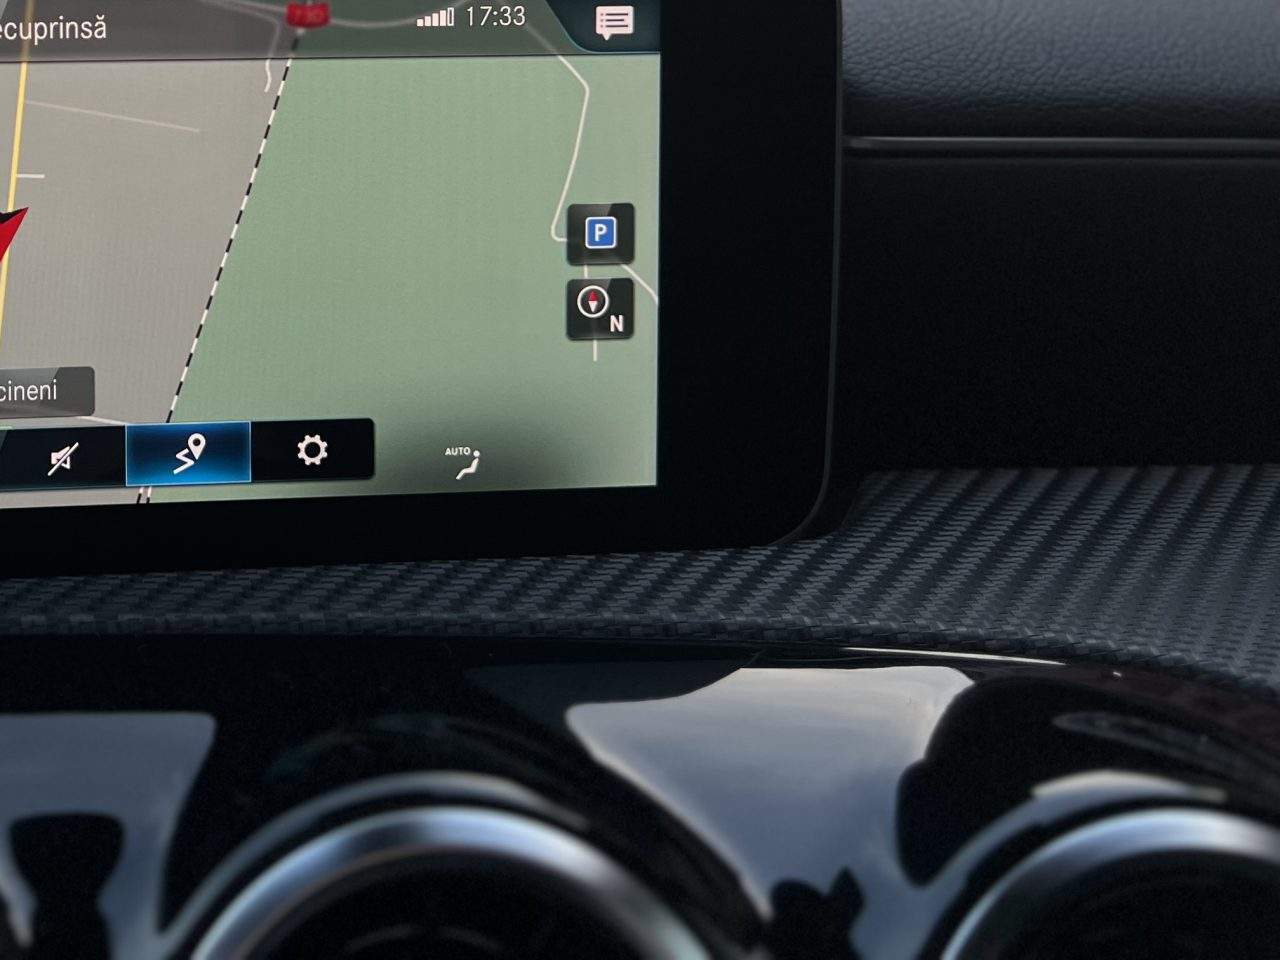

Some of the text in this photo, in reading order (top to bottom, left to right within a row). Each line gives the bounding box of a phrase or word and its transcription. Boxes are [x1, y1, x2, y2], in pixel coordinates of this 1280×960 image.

[467, 5, 526, 27] 17:33
[594, 223, 608, 242] P
[609, 314, 624, 332] N
[444, 446, 471, 456] AUTO
